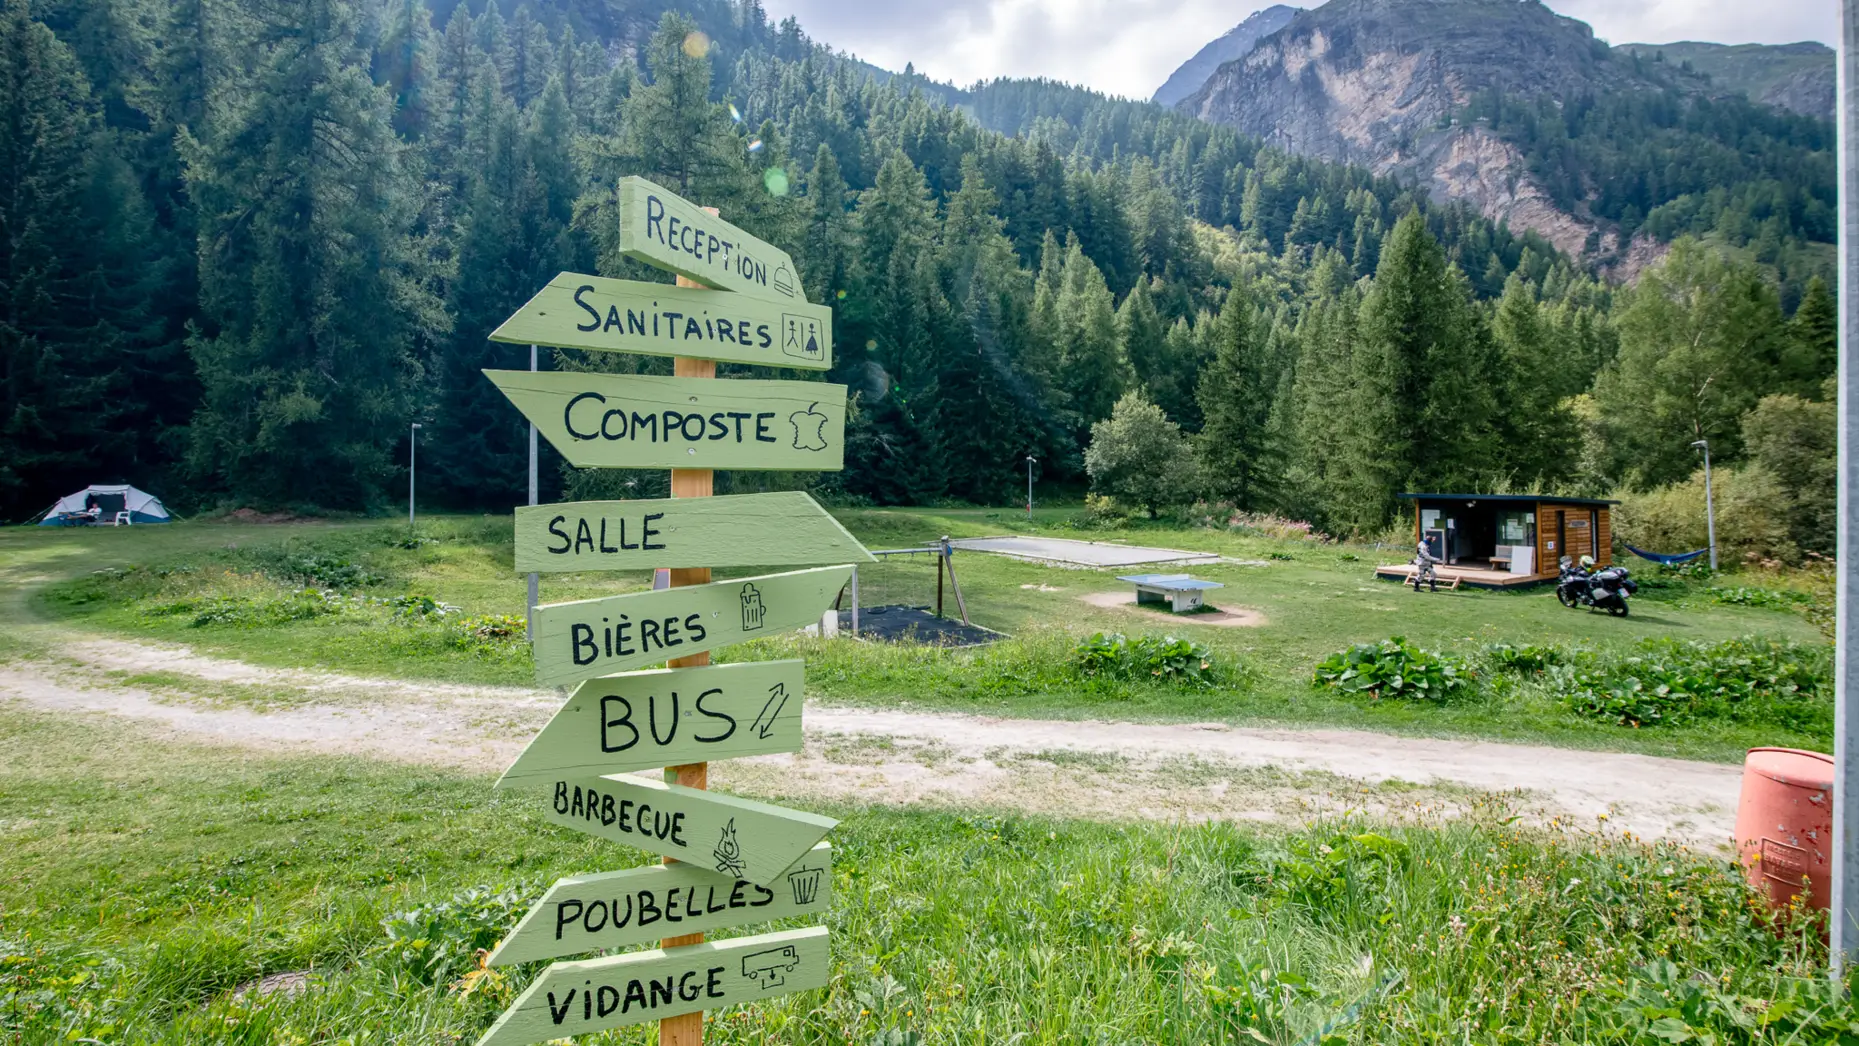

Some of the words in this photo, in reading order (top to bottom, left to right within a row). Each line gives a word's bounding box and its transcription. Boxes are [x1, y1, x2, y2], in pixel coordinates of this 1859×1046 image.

[564, 392, 777, 443] COMPOSTE
[547, 512, 666, 555] SALLE
[599, 688, 737, 754] BUS
[553, 780, 687, 848] BARBECUE
[556, 879, 774, 941] POUBELLES
